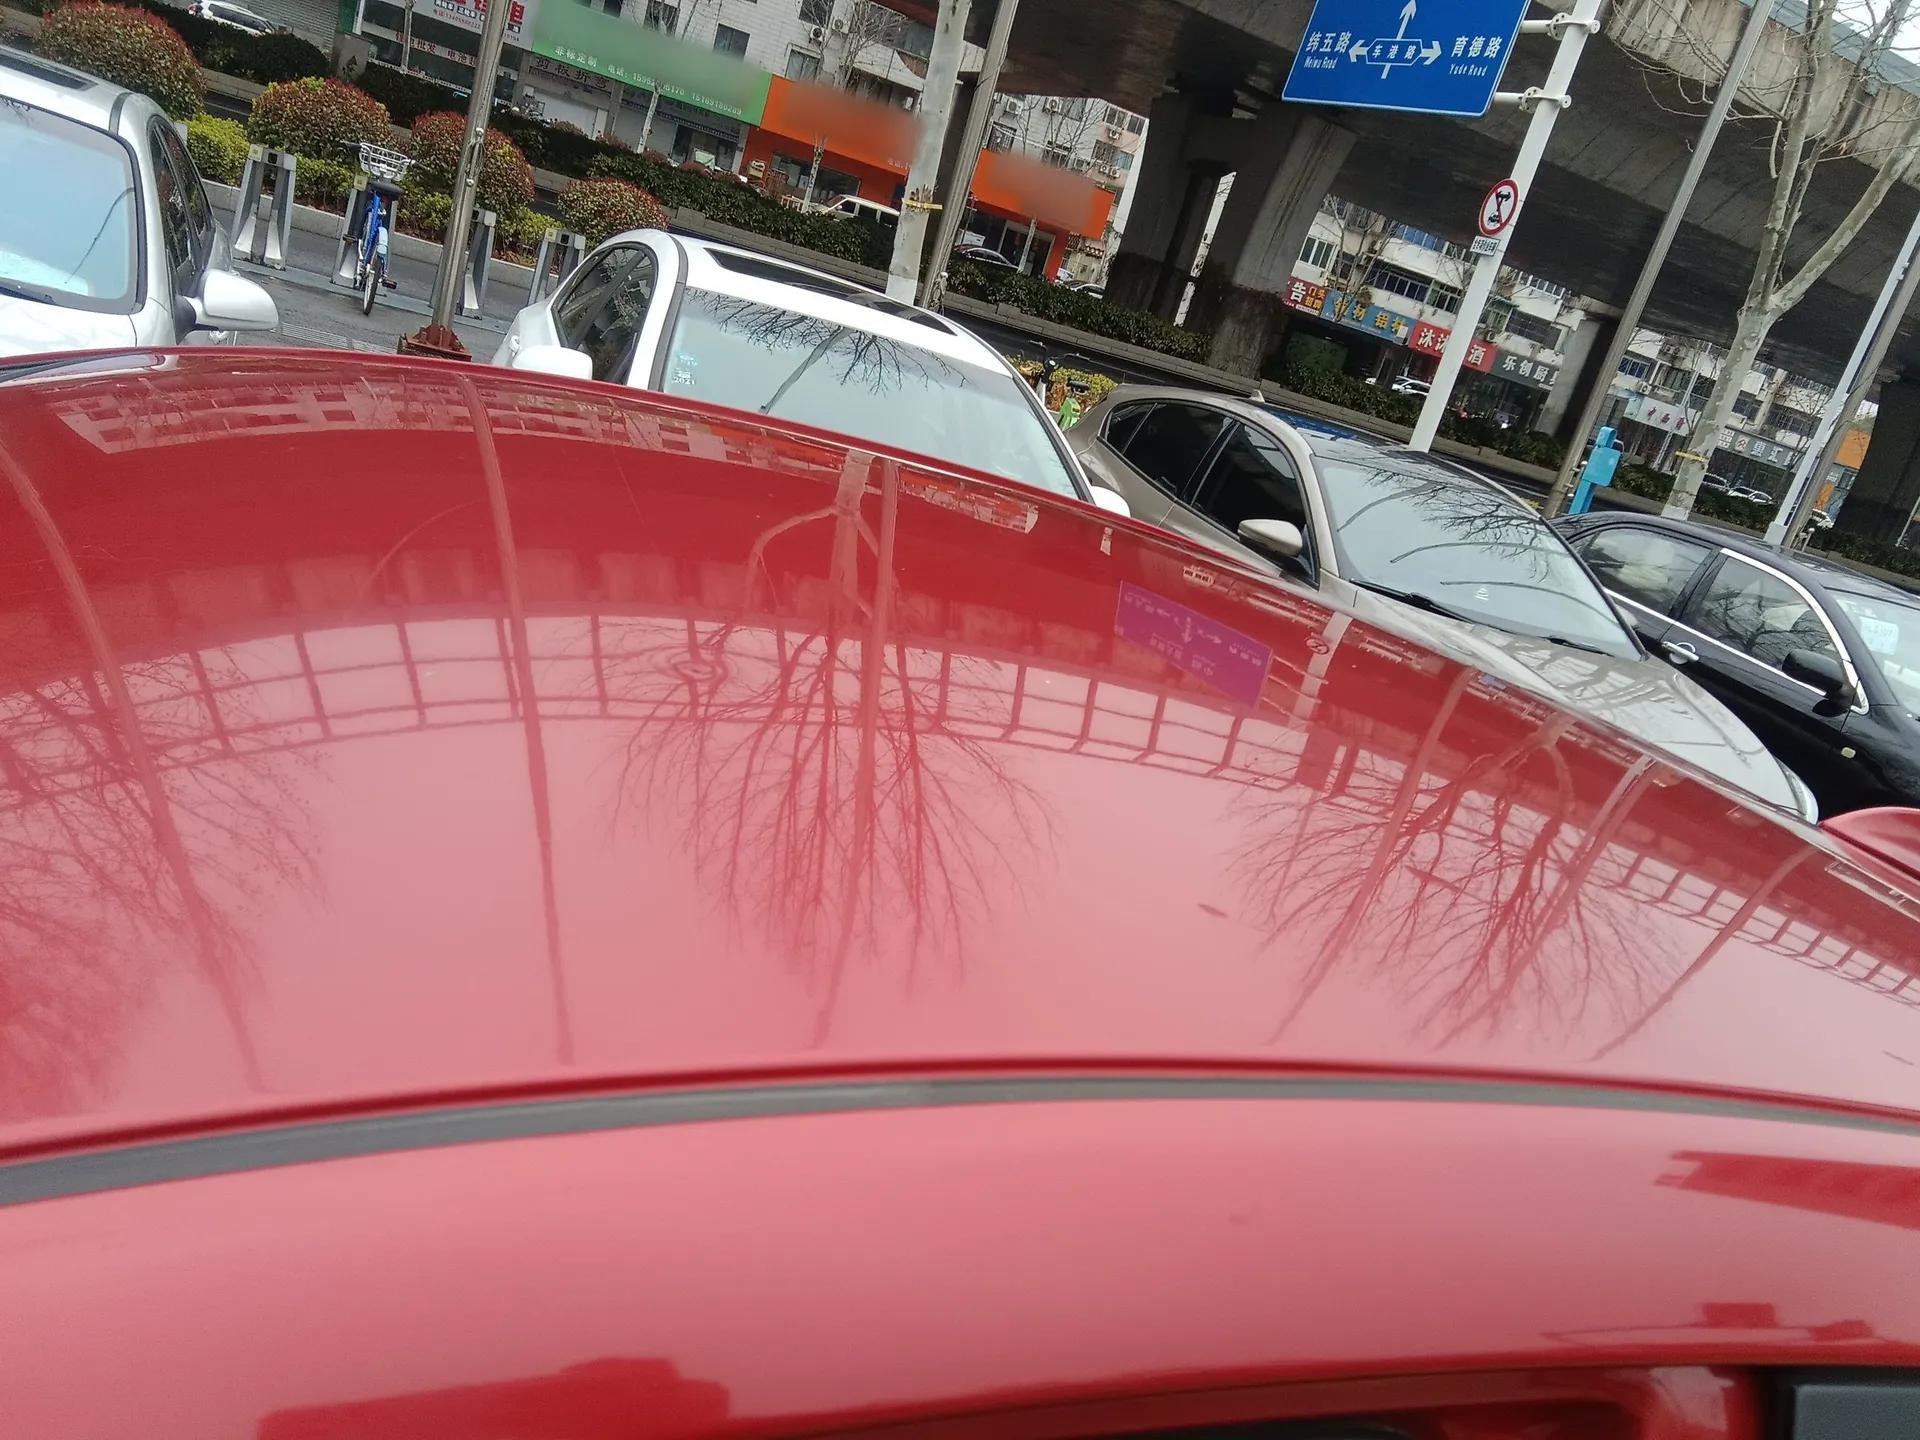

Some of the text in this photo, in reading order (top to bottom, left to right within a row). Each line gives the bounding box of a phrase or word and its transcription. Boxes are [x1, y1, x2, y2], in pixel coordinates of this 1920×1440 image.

[1305, 31, 1351, 54] 纬五路
[1450, 35, 1503, 59] 育德路
[1288, 281, 1307, 302] 告
